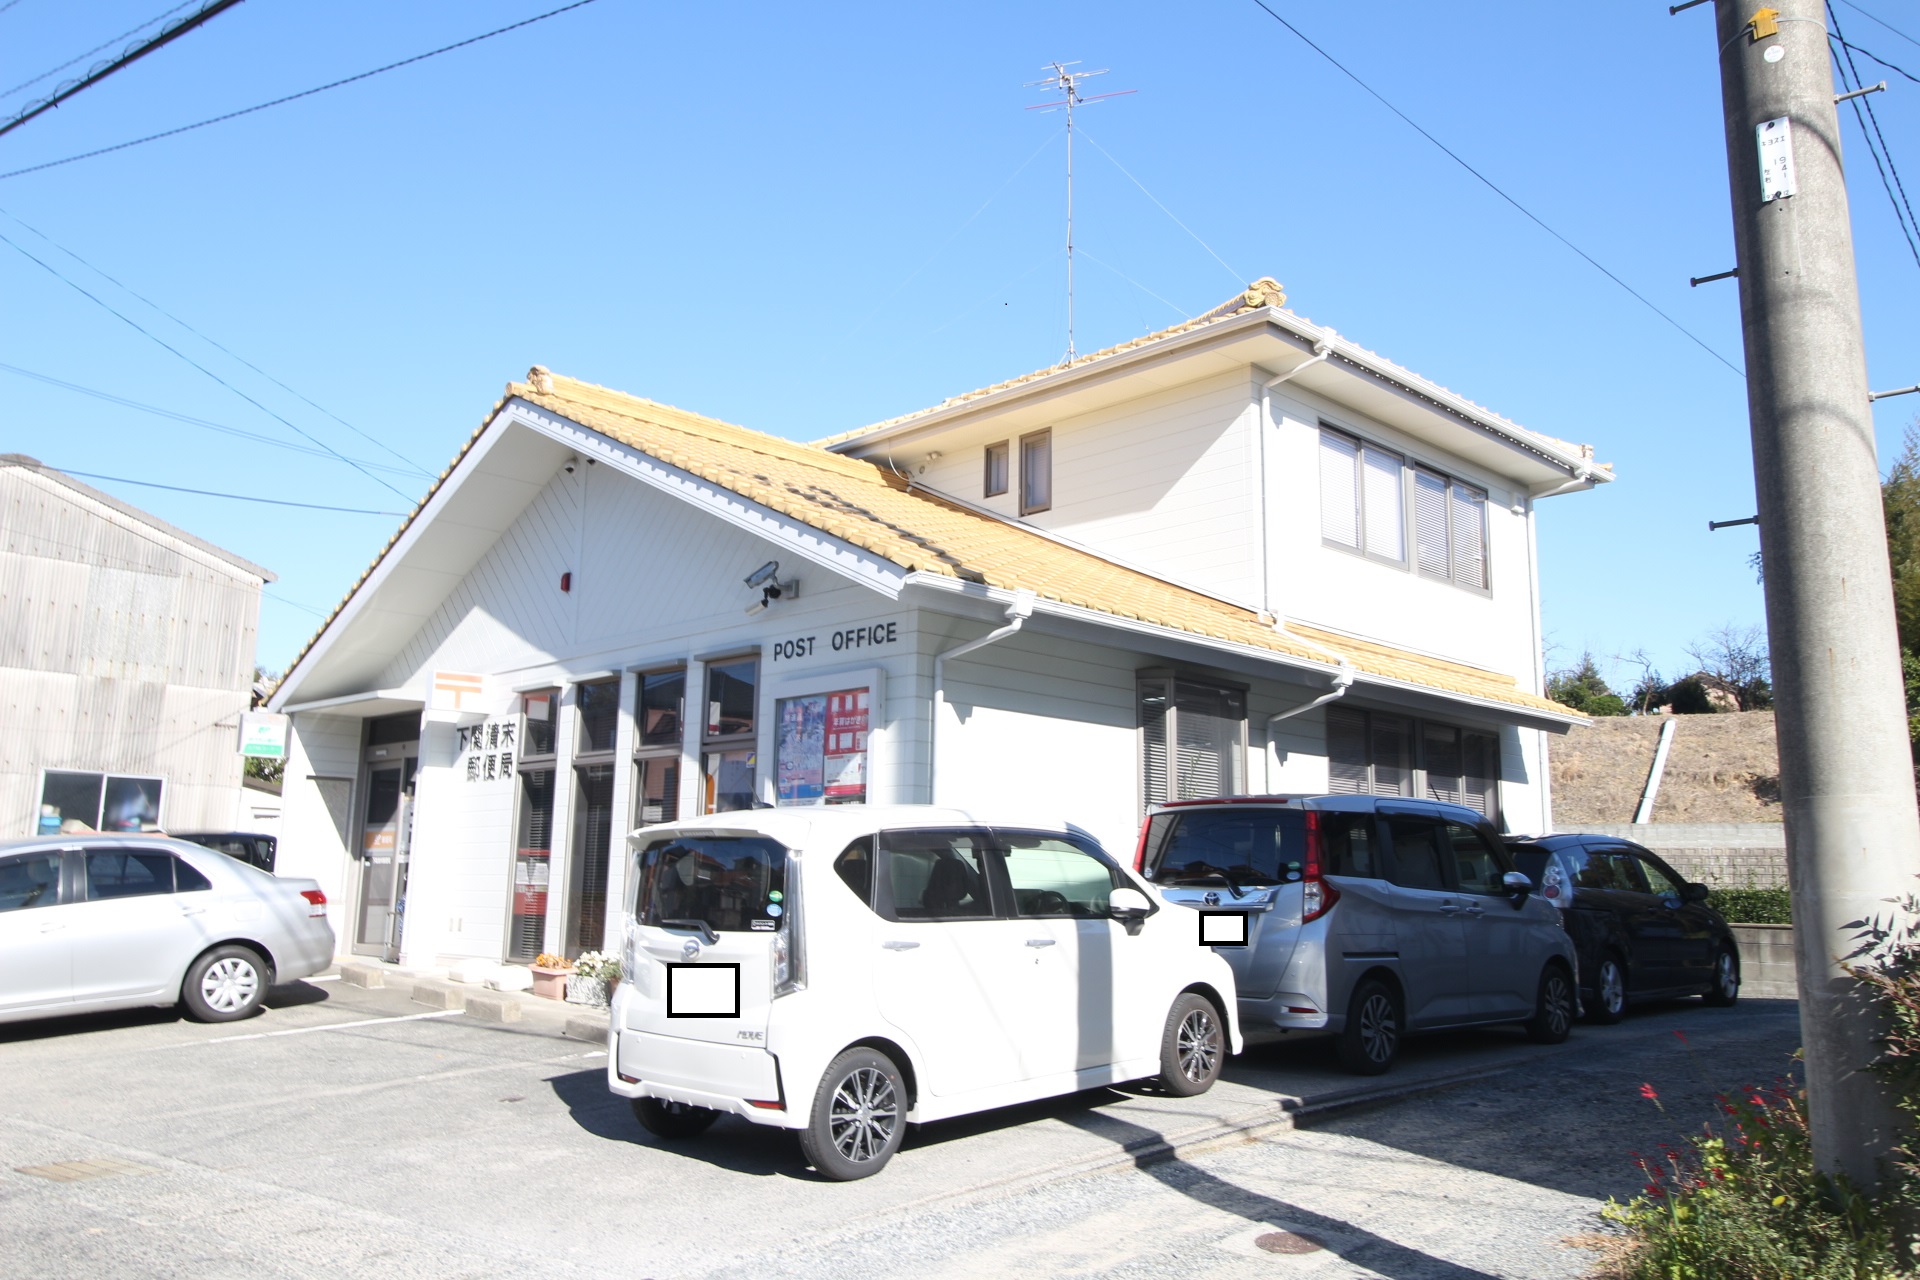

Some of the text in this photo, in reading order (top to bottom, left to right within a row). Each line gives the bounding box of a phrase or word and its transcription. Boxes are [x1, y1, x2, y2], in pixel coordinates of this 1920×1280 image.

[773, 622, 897, 662] POST OFFICE
[456, 720, 517, 752] 下関清末
[467, 752, 513, 783] 郵便局
